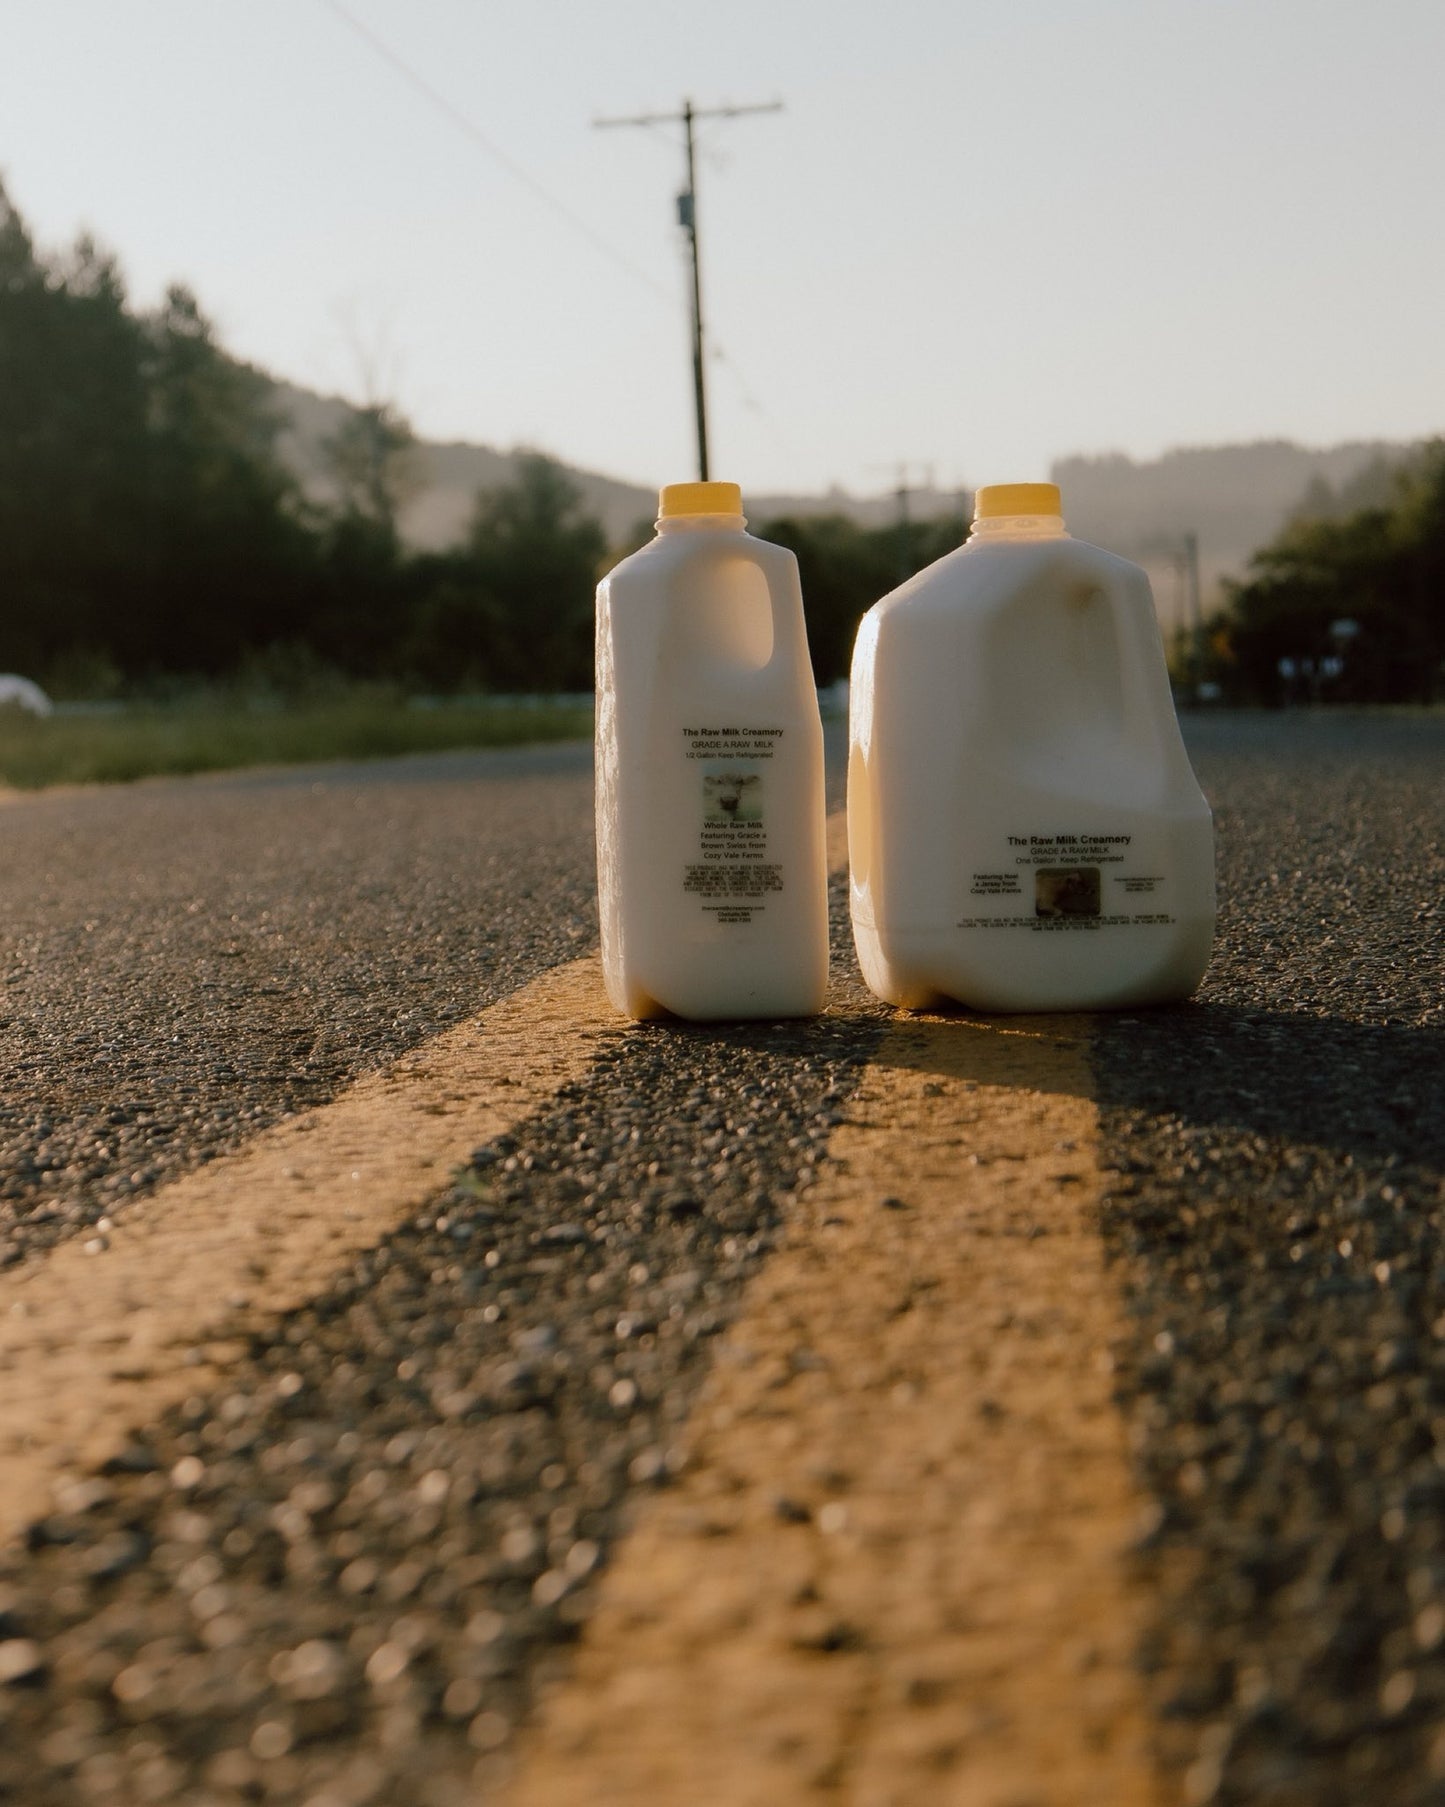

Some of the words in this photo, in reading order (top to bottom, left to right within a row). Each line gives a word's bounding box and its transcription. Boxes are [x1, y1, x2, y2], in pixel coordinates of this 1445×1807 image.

[683, 728, 699, 736] The
[701, 728, 720, 736] Raw
[722, 728, 740, 736] Milk
[742, 728, 784, 737] Creamery
[701, 832, 734, 840] Featuring
[1008, 836, 1027, 845] The
[1031, 836, 1053, 845] Raw
[1056, 836, 1077, 844] Milk
[1080, 835, 1131, 845] Creamery
[704, 852, 722, 860] Cozy
